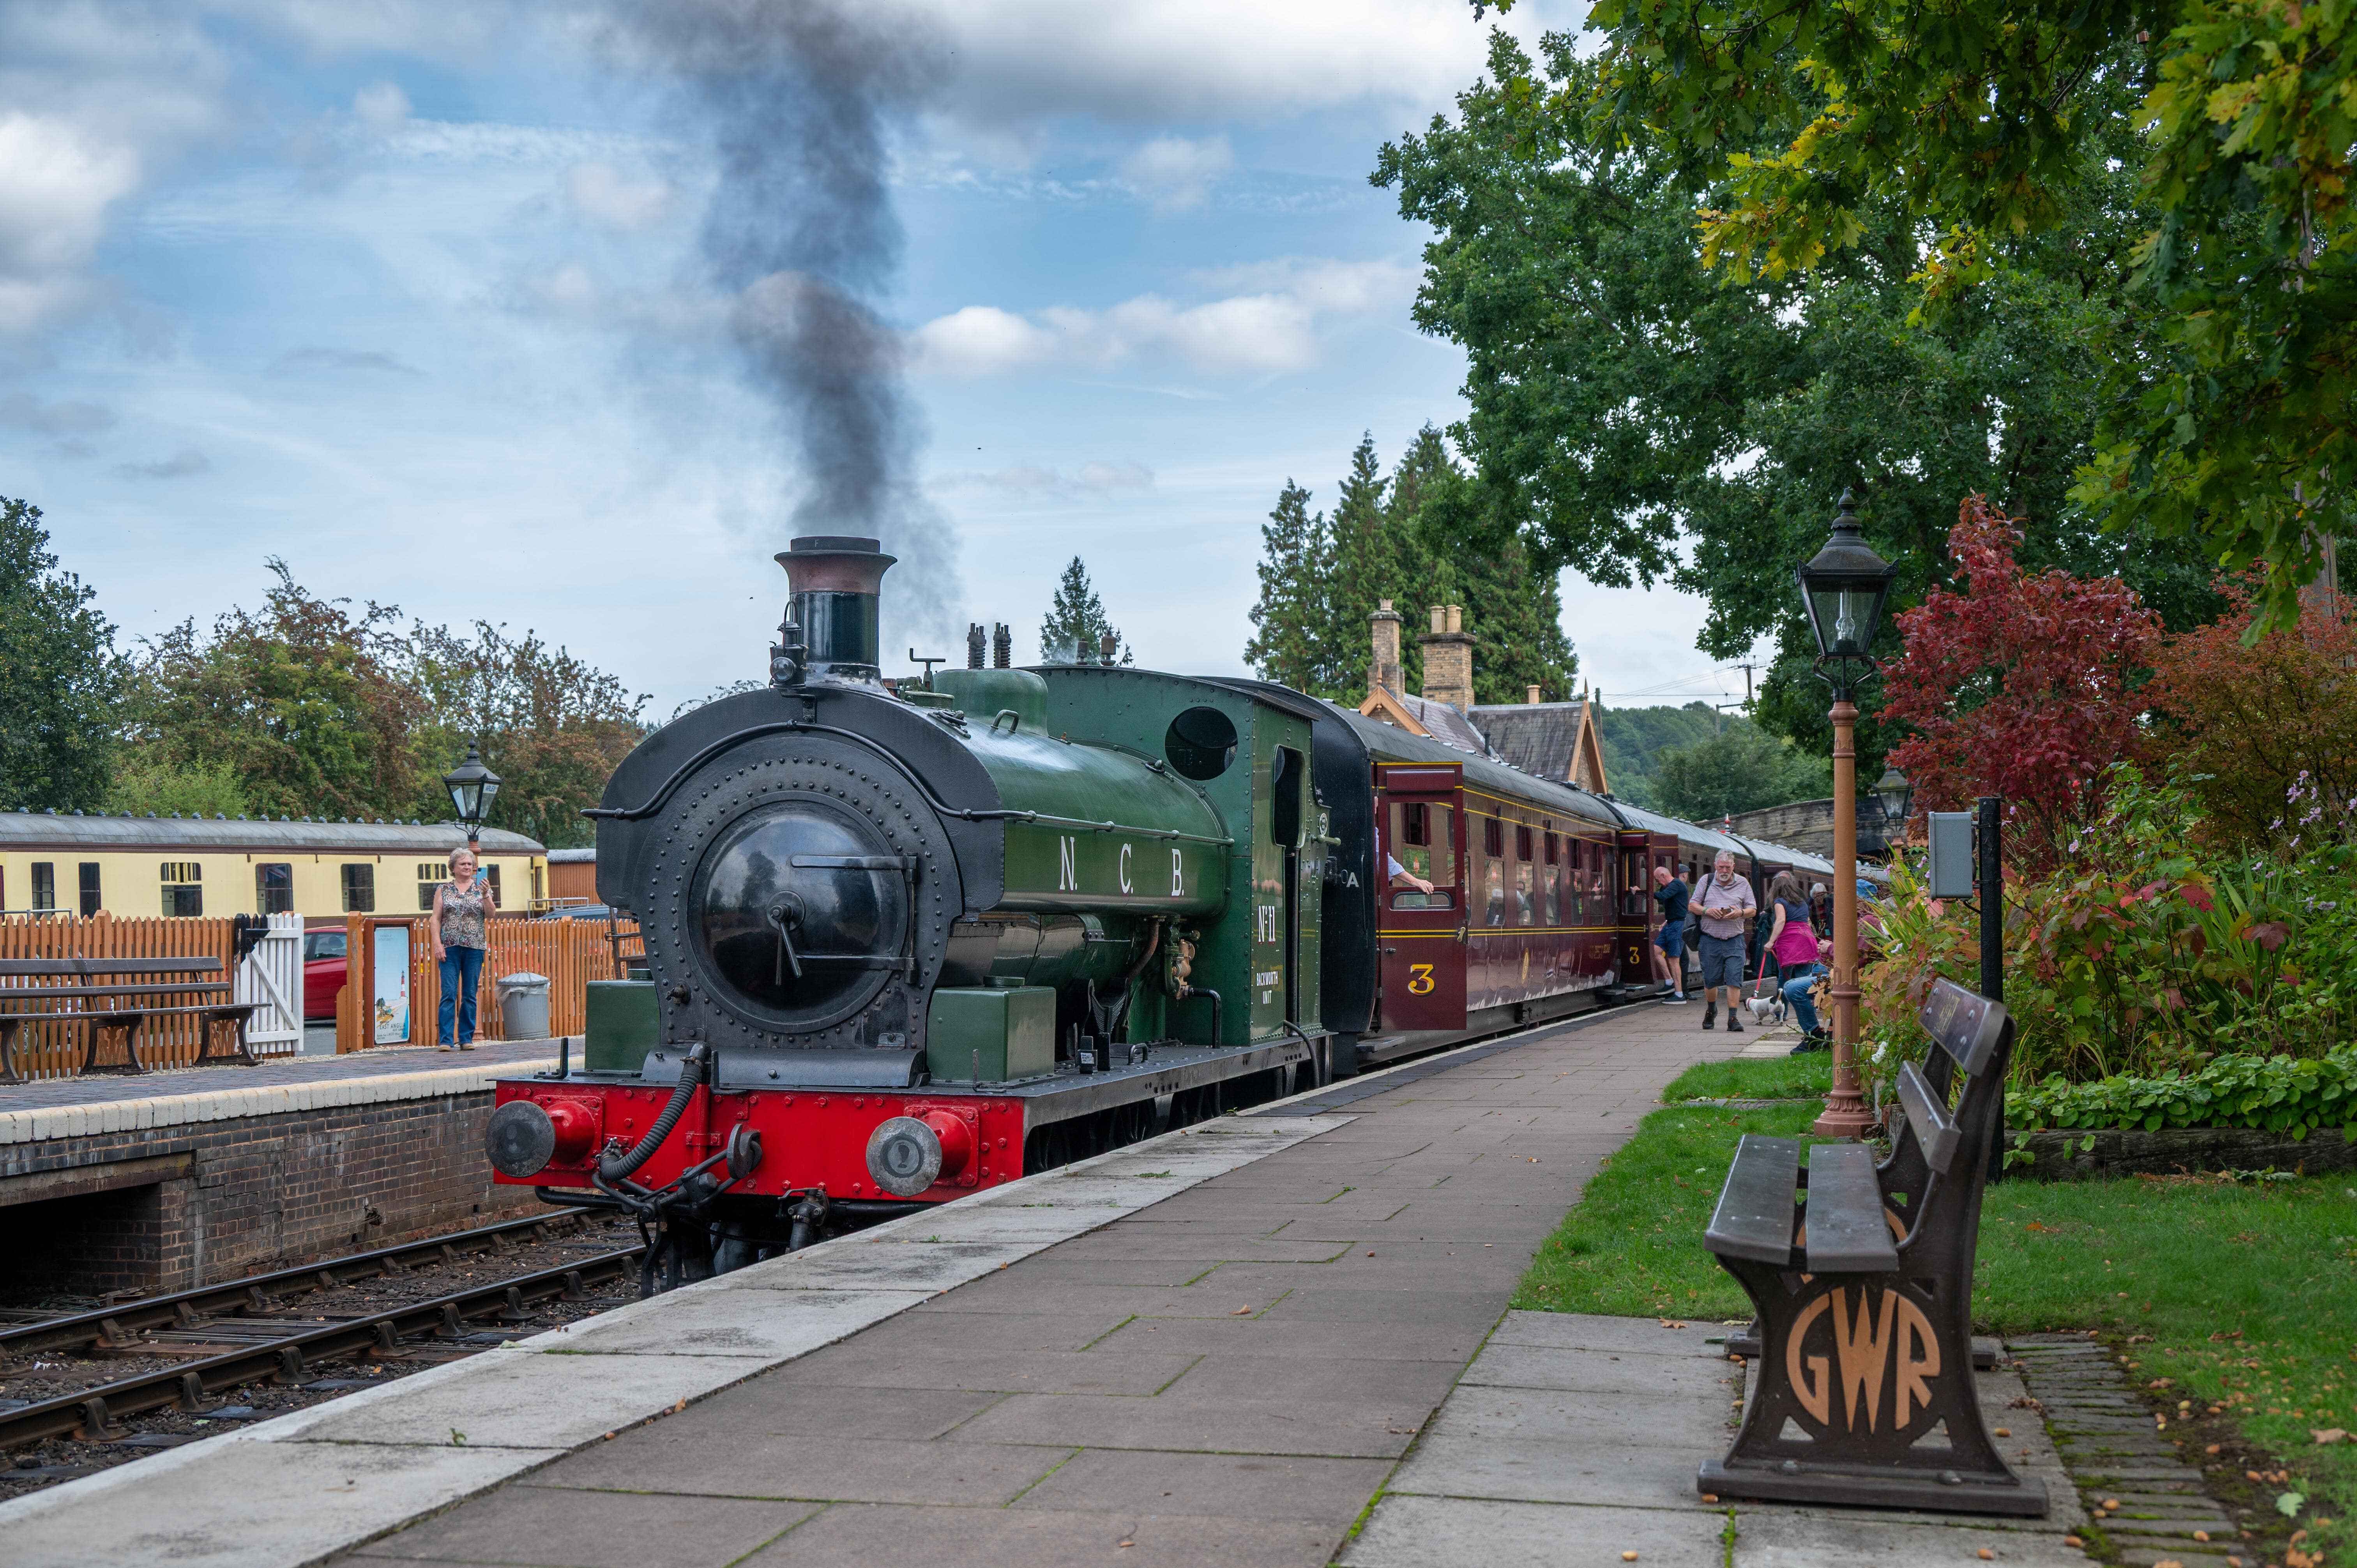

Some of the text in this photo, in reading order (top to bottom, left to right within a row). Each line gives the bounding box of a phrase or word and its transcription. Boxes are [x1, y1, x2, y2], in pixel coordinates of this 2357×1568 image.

[1346, 872, 1359, 887] A
[1629, 947, 1640, 964] 3
[1256, 971, 1278, 986] BACKWORTH
[1408, 964, 1435, 995] 3
[1263, 990, 1272, 1004] UNIT
[1786, 1284, 1940, 1434] GWR
